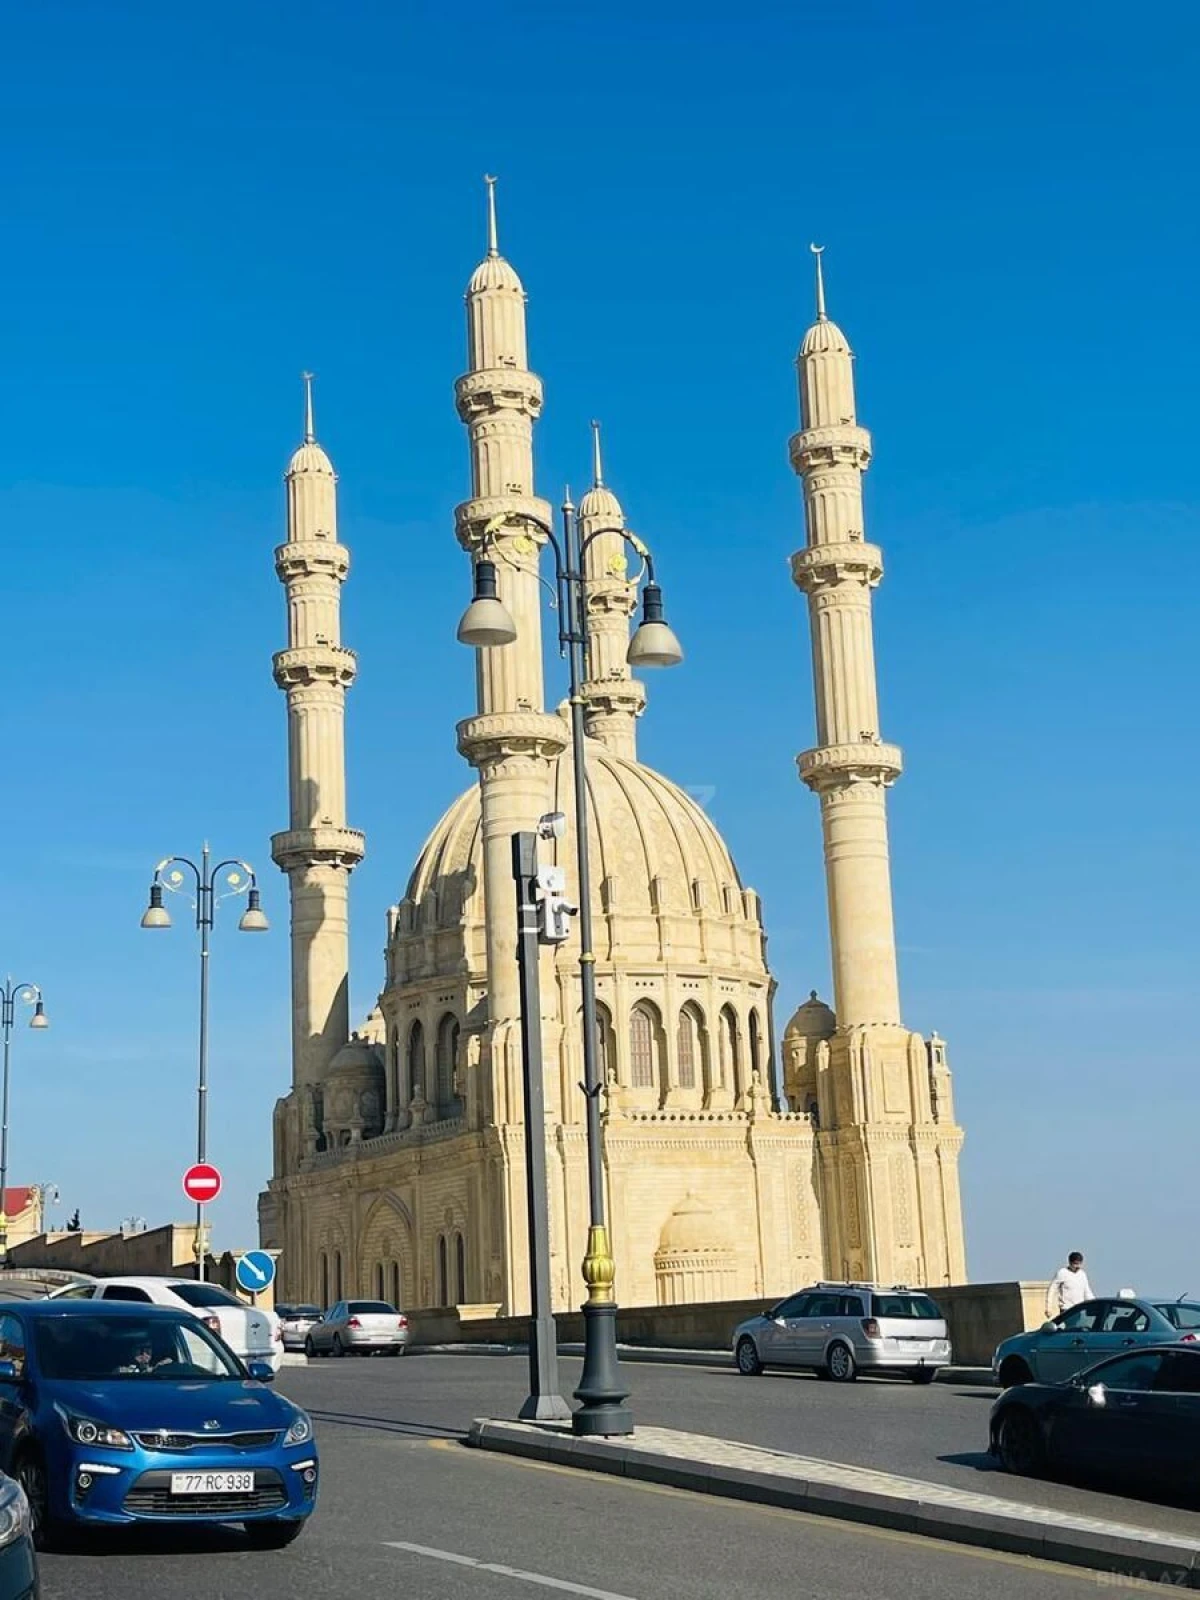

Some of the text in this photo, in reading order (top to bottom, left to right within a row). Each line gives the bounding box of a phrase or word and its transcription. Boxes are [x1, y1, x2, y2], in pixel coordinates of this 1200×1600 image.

[186, 1474, 250, 1490] 77 RC 938
